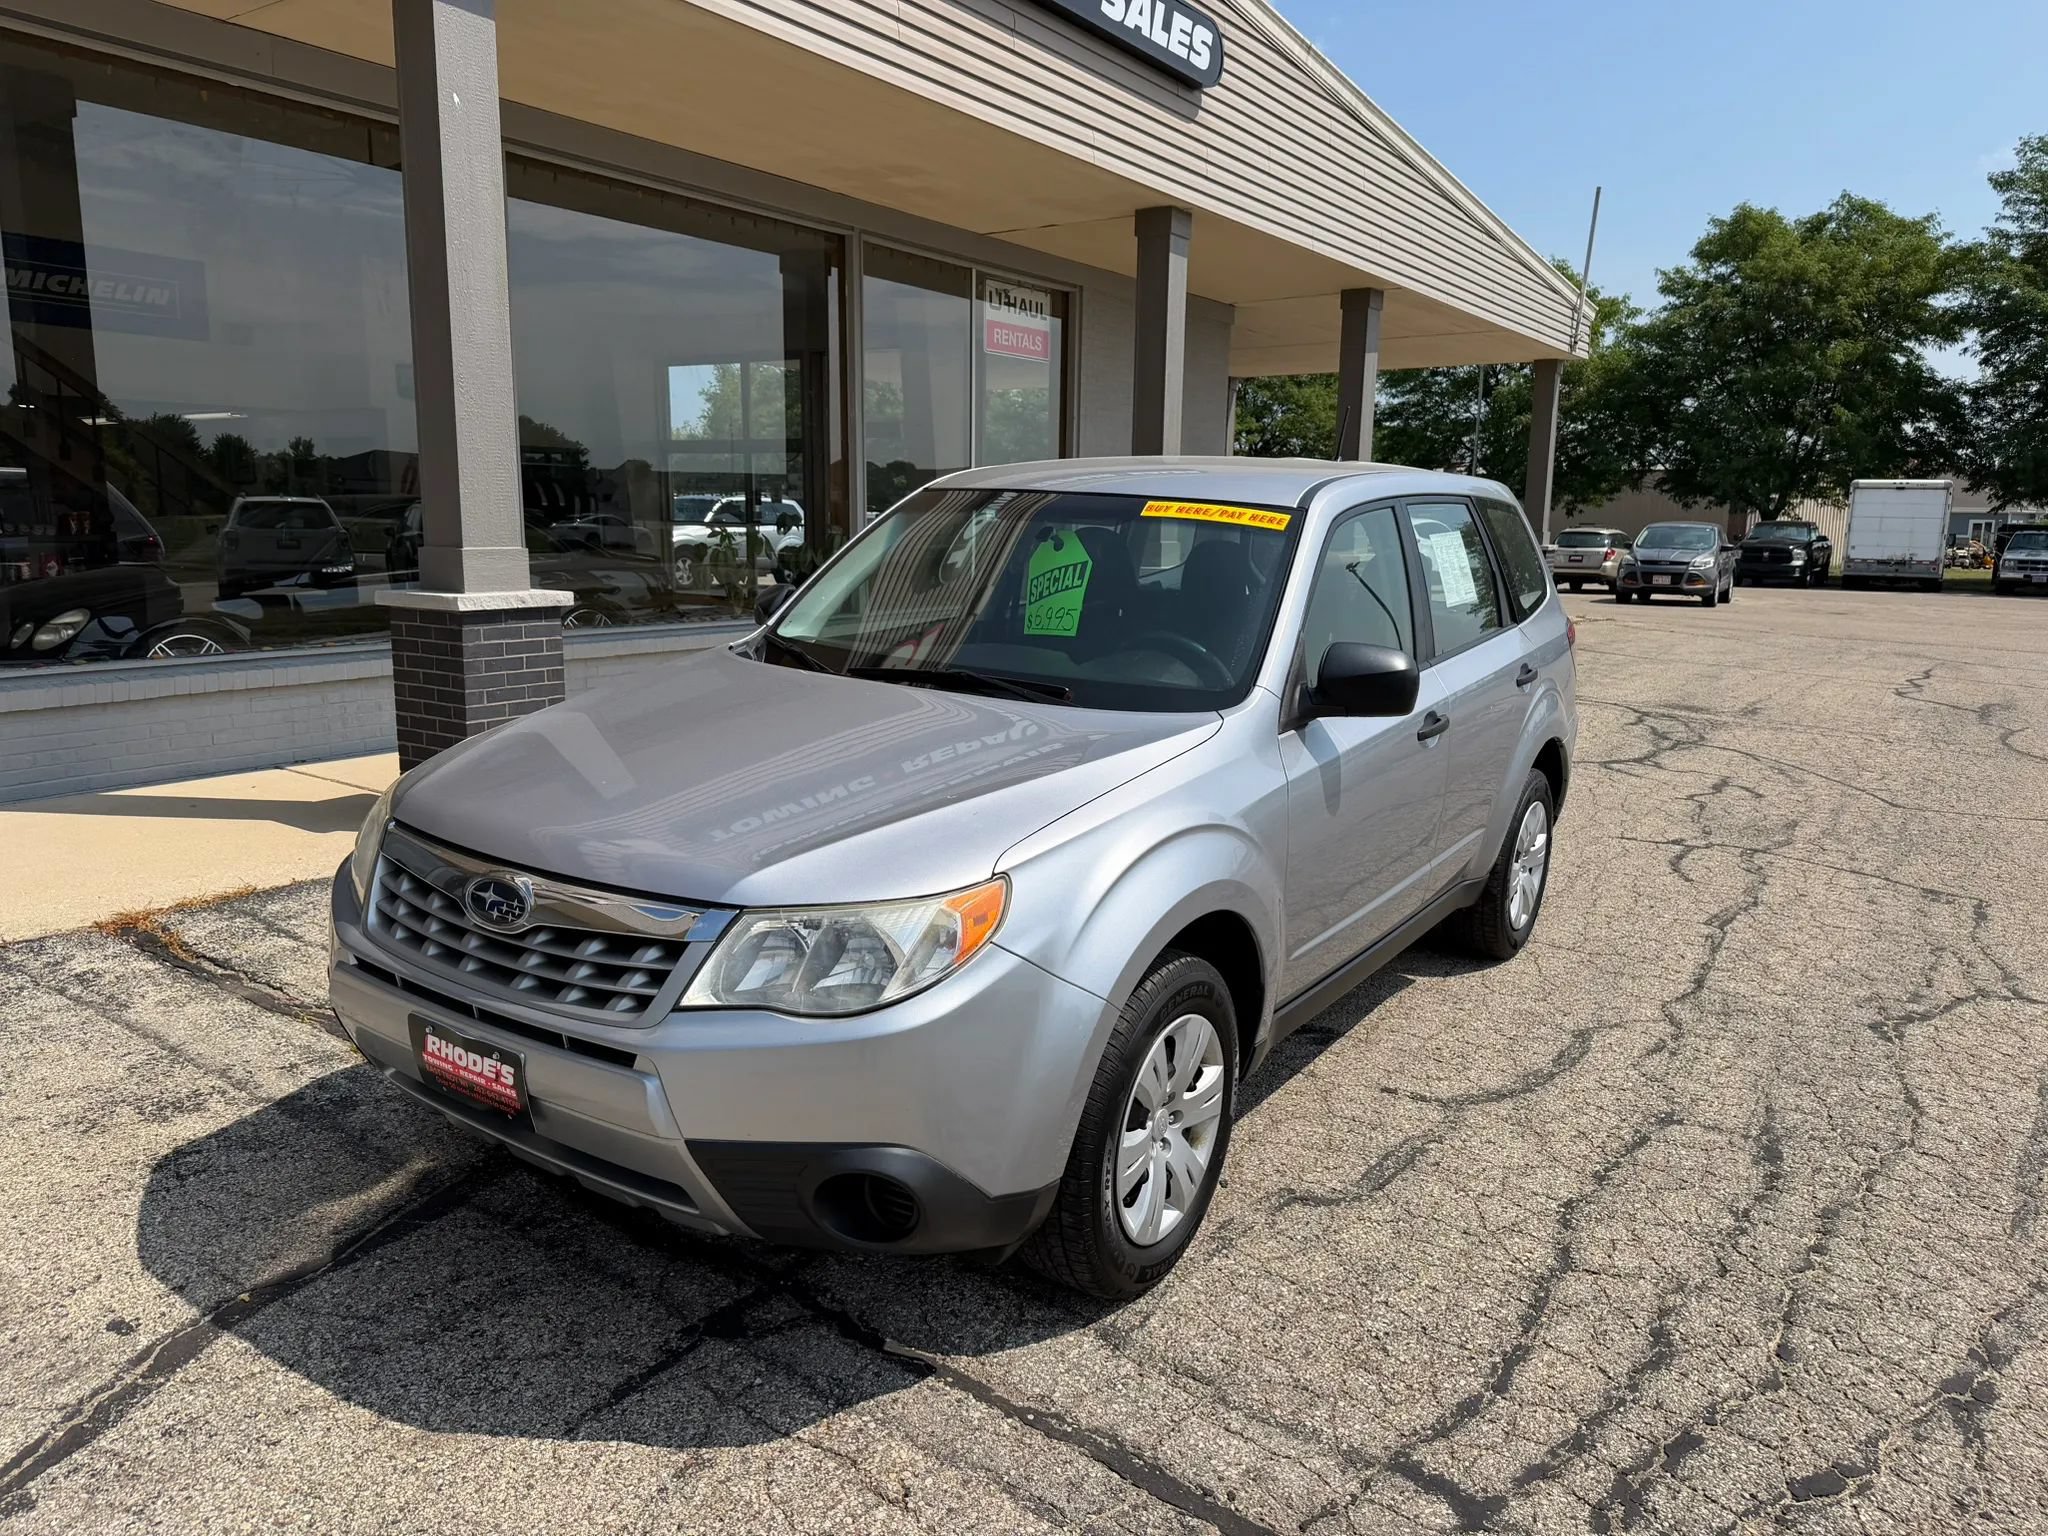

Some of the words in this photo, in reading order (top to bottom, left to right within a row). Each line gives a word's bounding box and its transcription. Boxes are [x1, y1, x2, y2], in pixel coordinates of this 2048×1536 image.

[1100, 0, 1213, 71] SALES
[5, 267, 170, 306] MICHELIN
[993, 327, 1042, 352] RENTALS
[1145, 504, 1170, 513] BUY
[1175, 504, 1248, 520] HERE/PAY
[1248, 512, 1287, 526] HERE
[1031, 563, 1083, 603] SPECIAL
[1159, 984, 1209, 1022] GENERAL
[425, 1033, 516, 1086] RHODE'S
[491, 1081, 518, 1098] SALES
